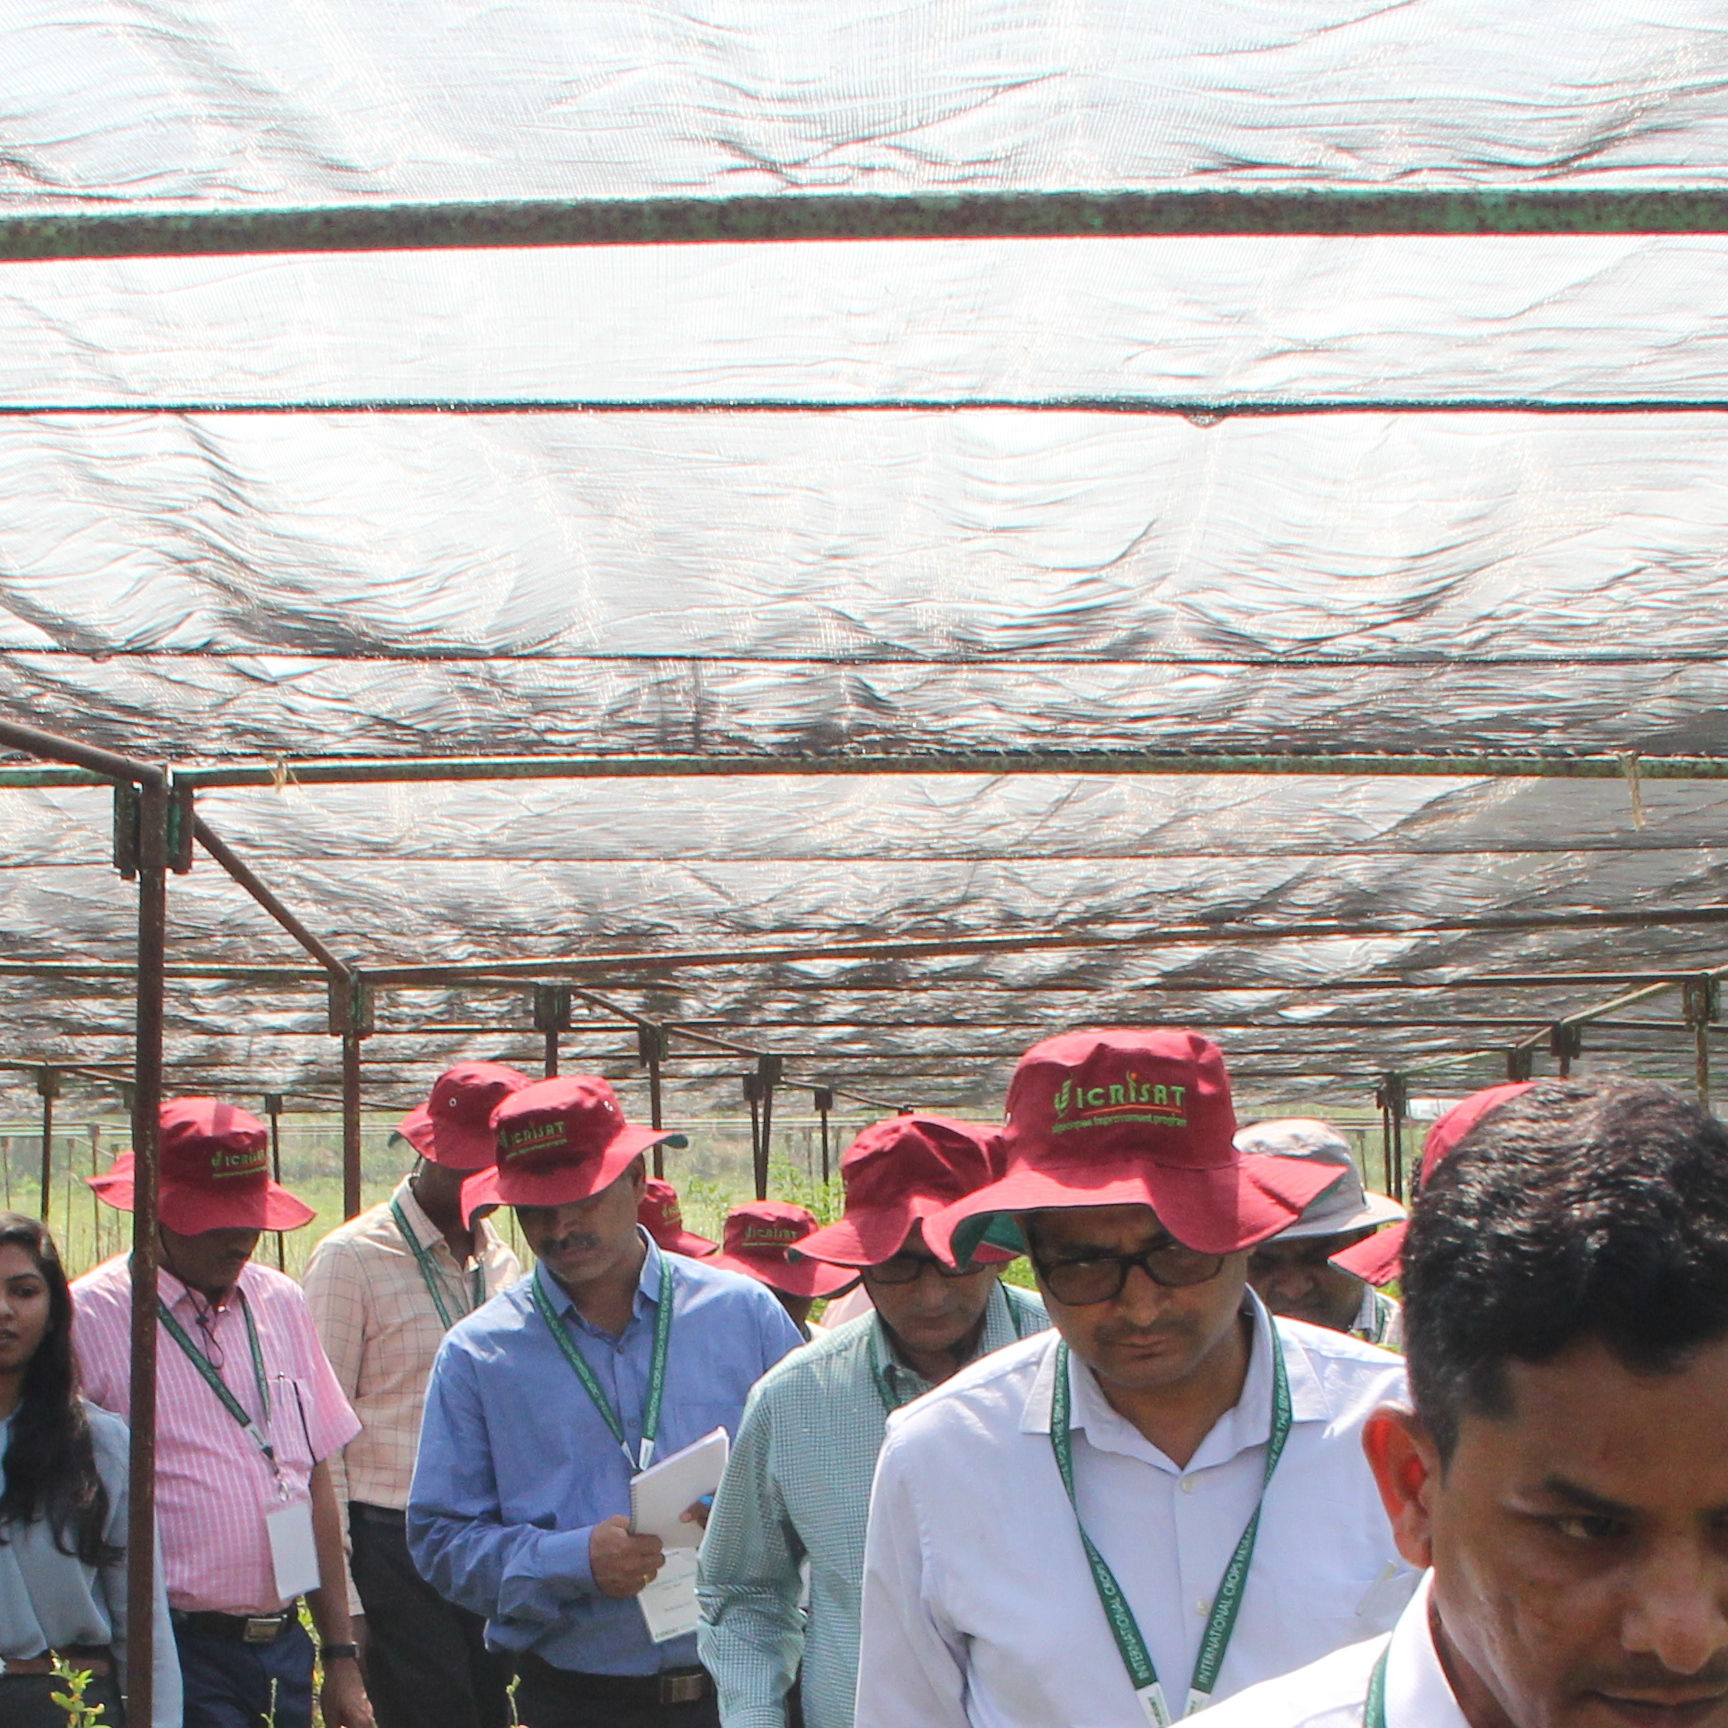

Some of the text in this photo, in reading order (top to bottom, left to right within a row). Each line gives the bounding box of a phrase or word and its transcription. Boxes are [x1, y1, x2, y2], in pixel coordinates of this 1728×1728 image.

[1076, 1072, 1186, 1108] ICRISAT
[511, 1121, 565, 1145] ICRISAT
[1107, 1596, 1151, 1681] INTERNATIONAL
[1198, 1598, 1234, 1685] INTERNATIONAL
[1223, 1563, 1244, 1597] CROPS
